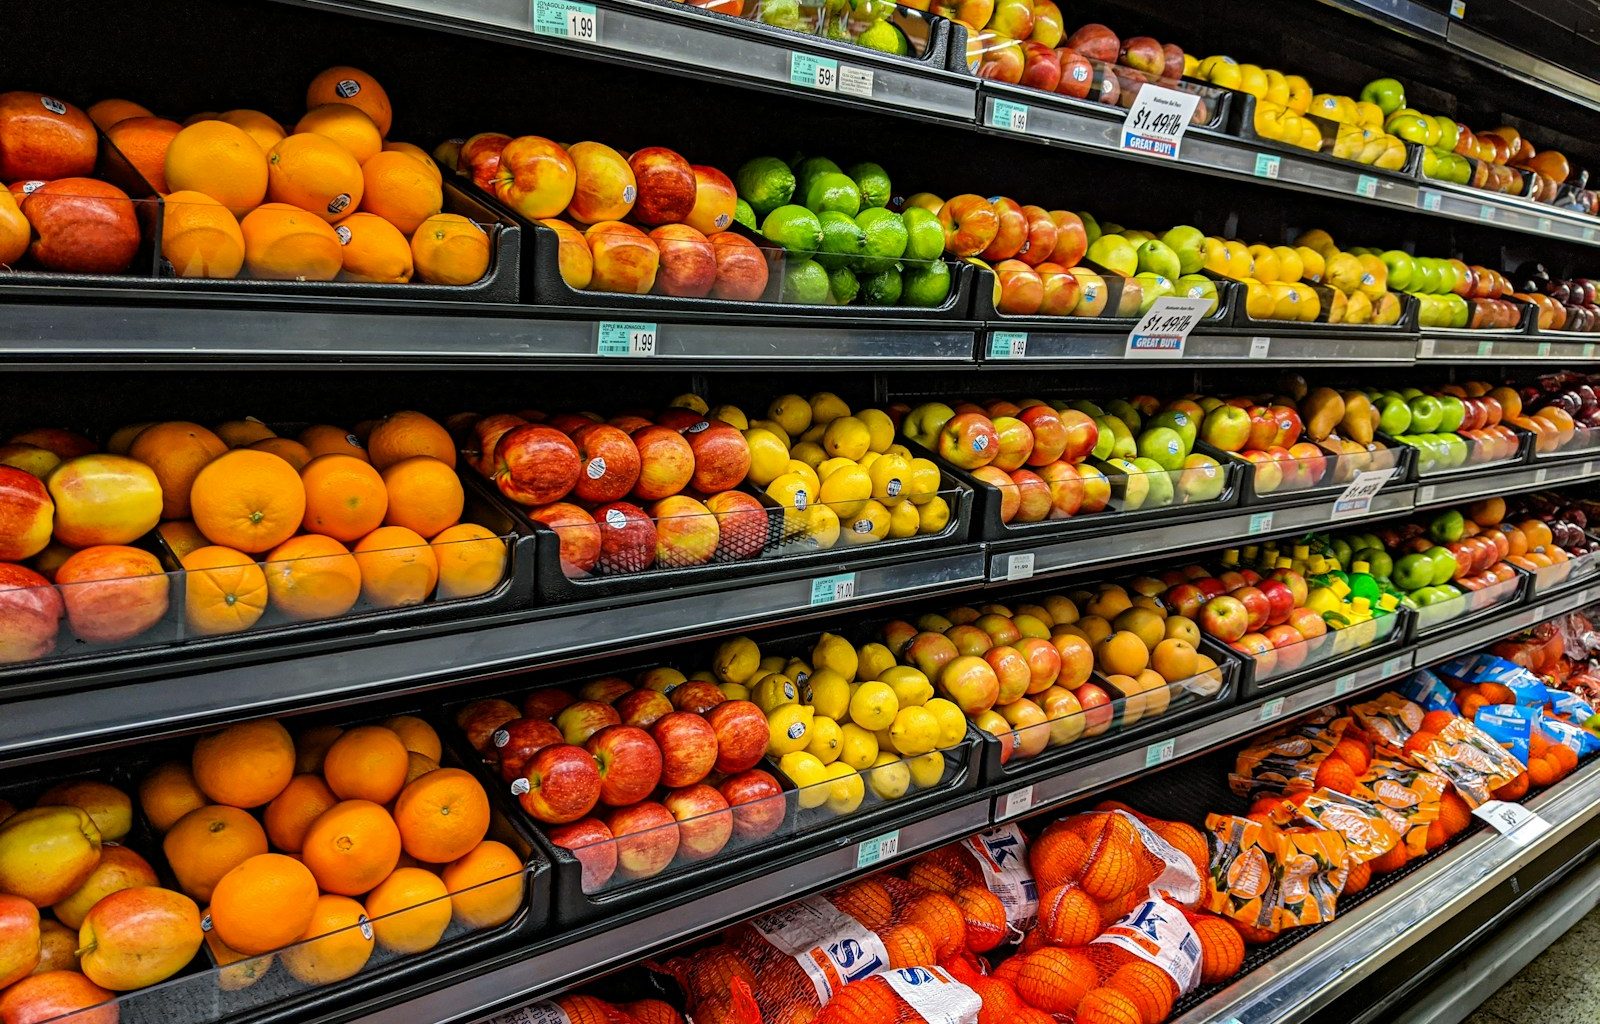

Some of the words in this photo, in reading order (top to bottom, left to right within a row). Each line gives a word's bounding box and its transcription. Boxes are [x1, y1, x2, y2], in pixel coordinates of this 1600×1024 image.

[537, 1, 564, 10] JONAGOLD
[572, 16, 592, 38] 1.99
[819, 68, 834, 85] 59¢
[1013, 113, 1025, 129] 1.99
[1133, 106, 1169, 133] $1.49
[1130, 136, 1154, 151] GREAT
[1154, 142, 1172, 154] BUY!
[1142, 314, 1180, 332] $1.49
[634, 333, 653, 351] 1.99
[1013, 341, 1024, 354] 1.99
[1136, 338, 1160, 347] GREAT
[1160, 339, 1177, 348] BUY!
